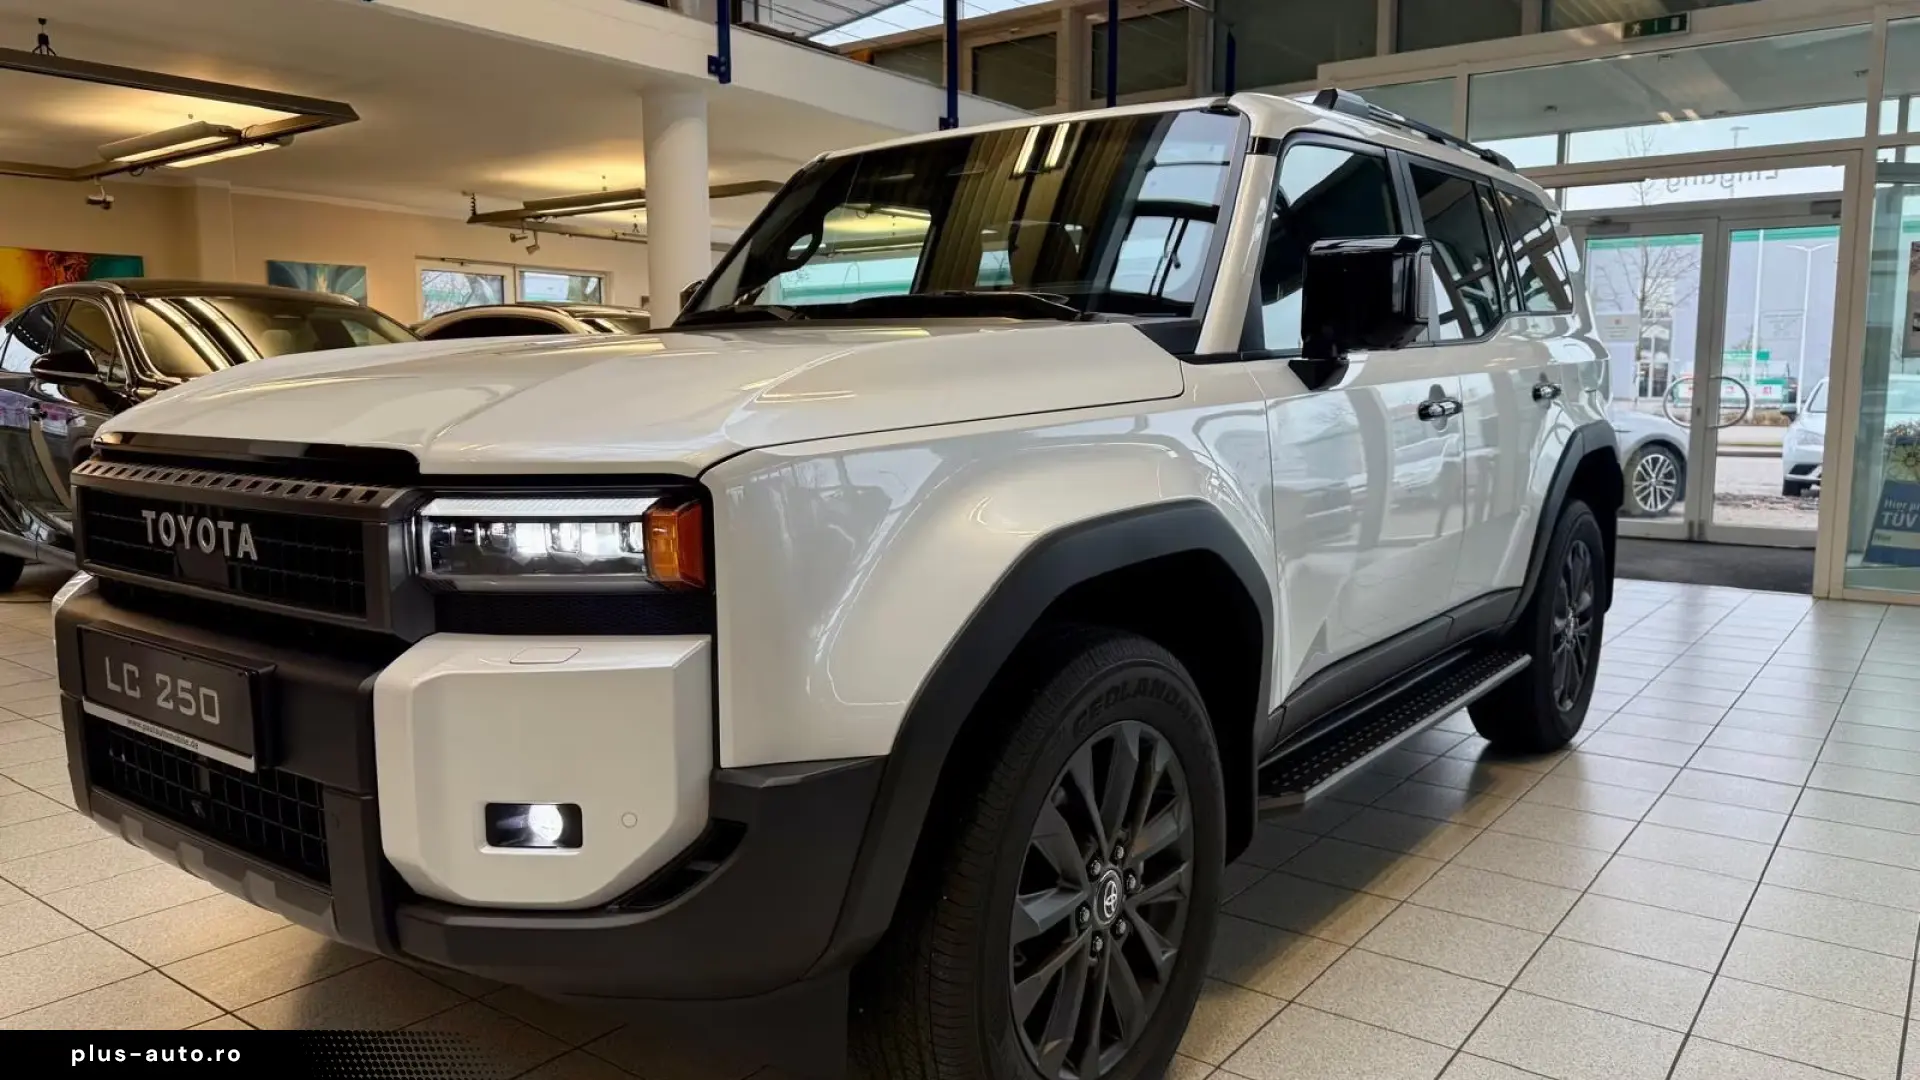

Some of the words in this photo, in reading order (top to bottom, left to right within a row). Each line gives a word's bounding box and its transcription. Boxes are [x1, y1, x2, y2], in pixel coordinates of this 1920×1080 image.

[141, 509, 258, 561] TOYOTA
[1881, 509, 1919, 528] TÜV
[105, 656, 142, 699] LC
[155, 672, 220, 725] 250
